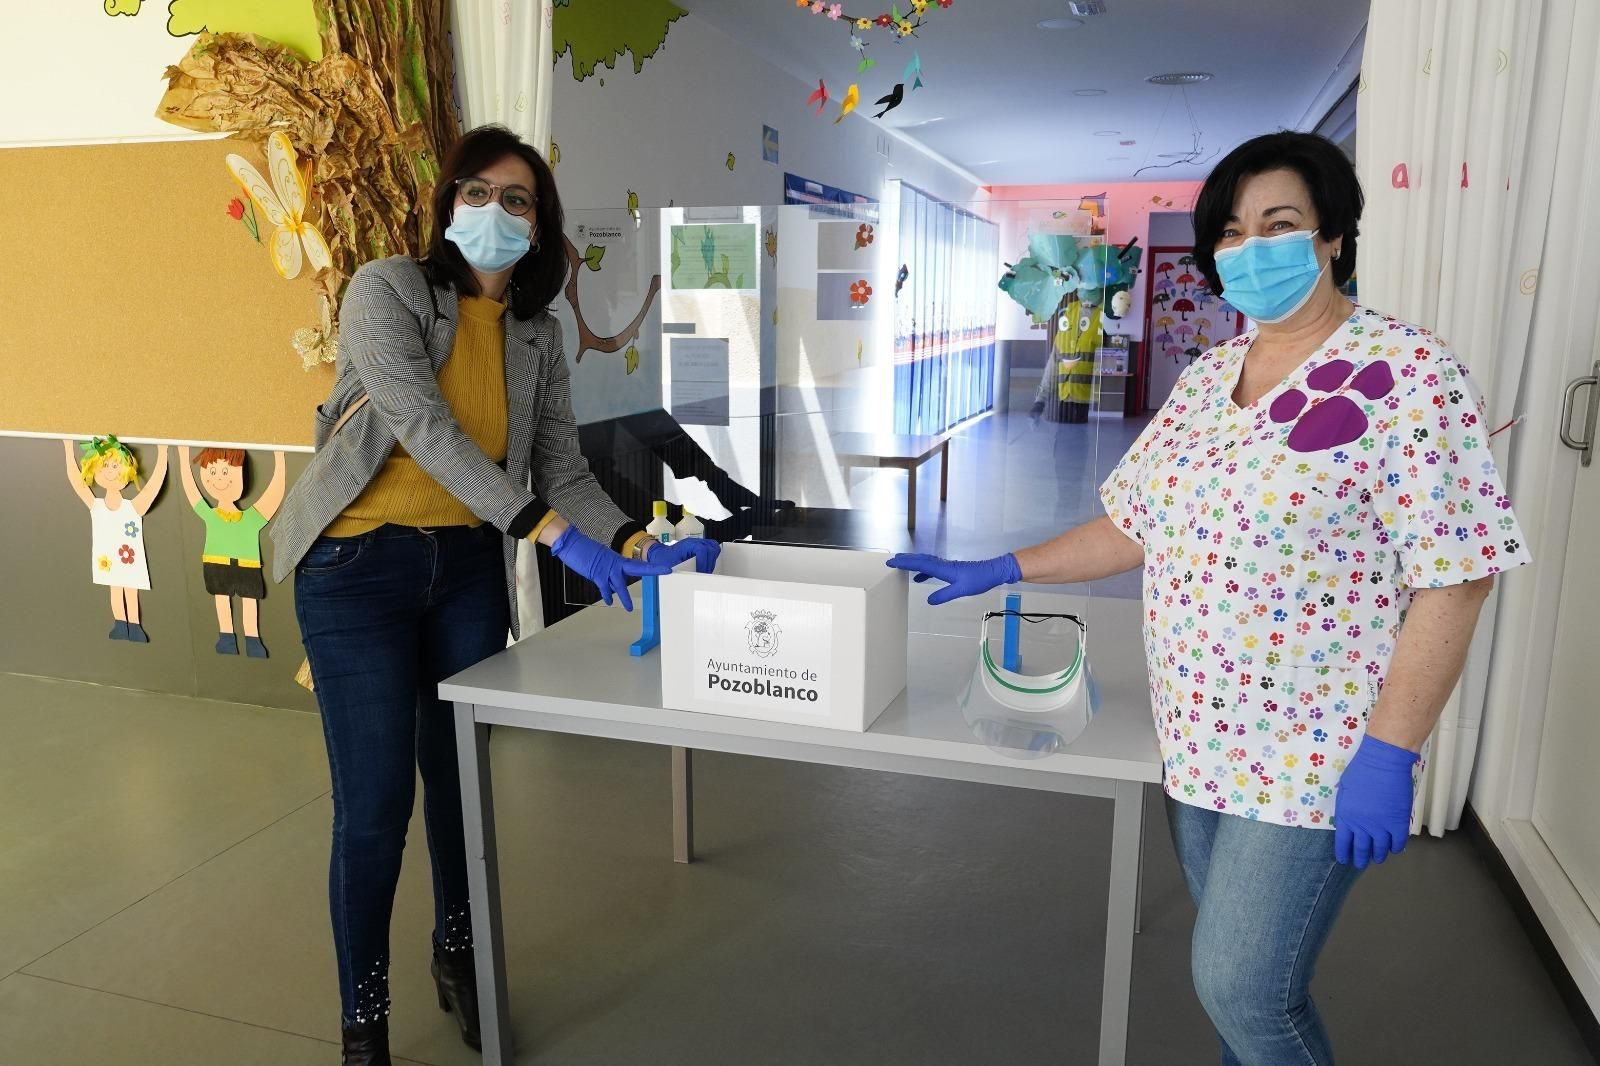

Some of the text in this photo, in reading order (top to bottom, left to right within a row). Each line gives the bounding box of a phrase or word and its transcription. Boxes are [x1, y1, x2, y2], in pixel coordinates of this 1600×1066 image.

[707, 658, 818, 682] Ayuntamiento de
[708, 673, 819, 702] Pozoblanco
